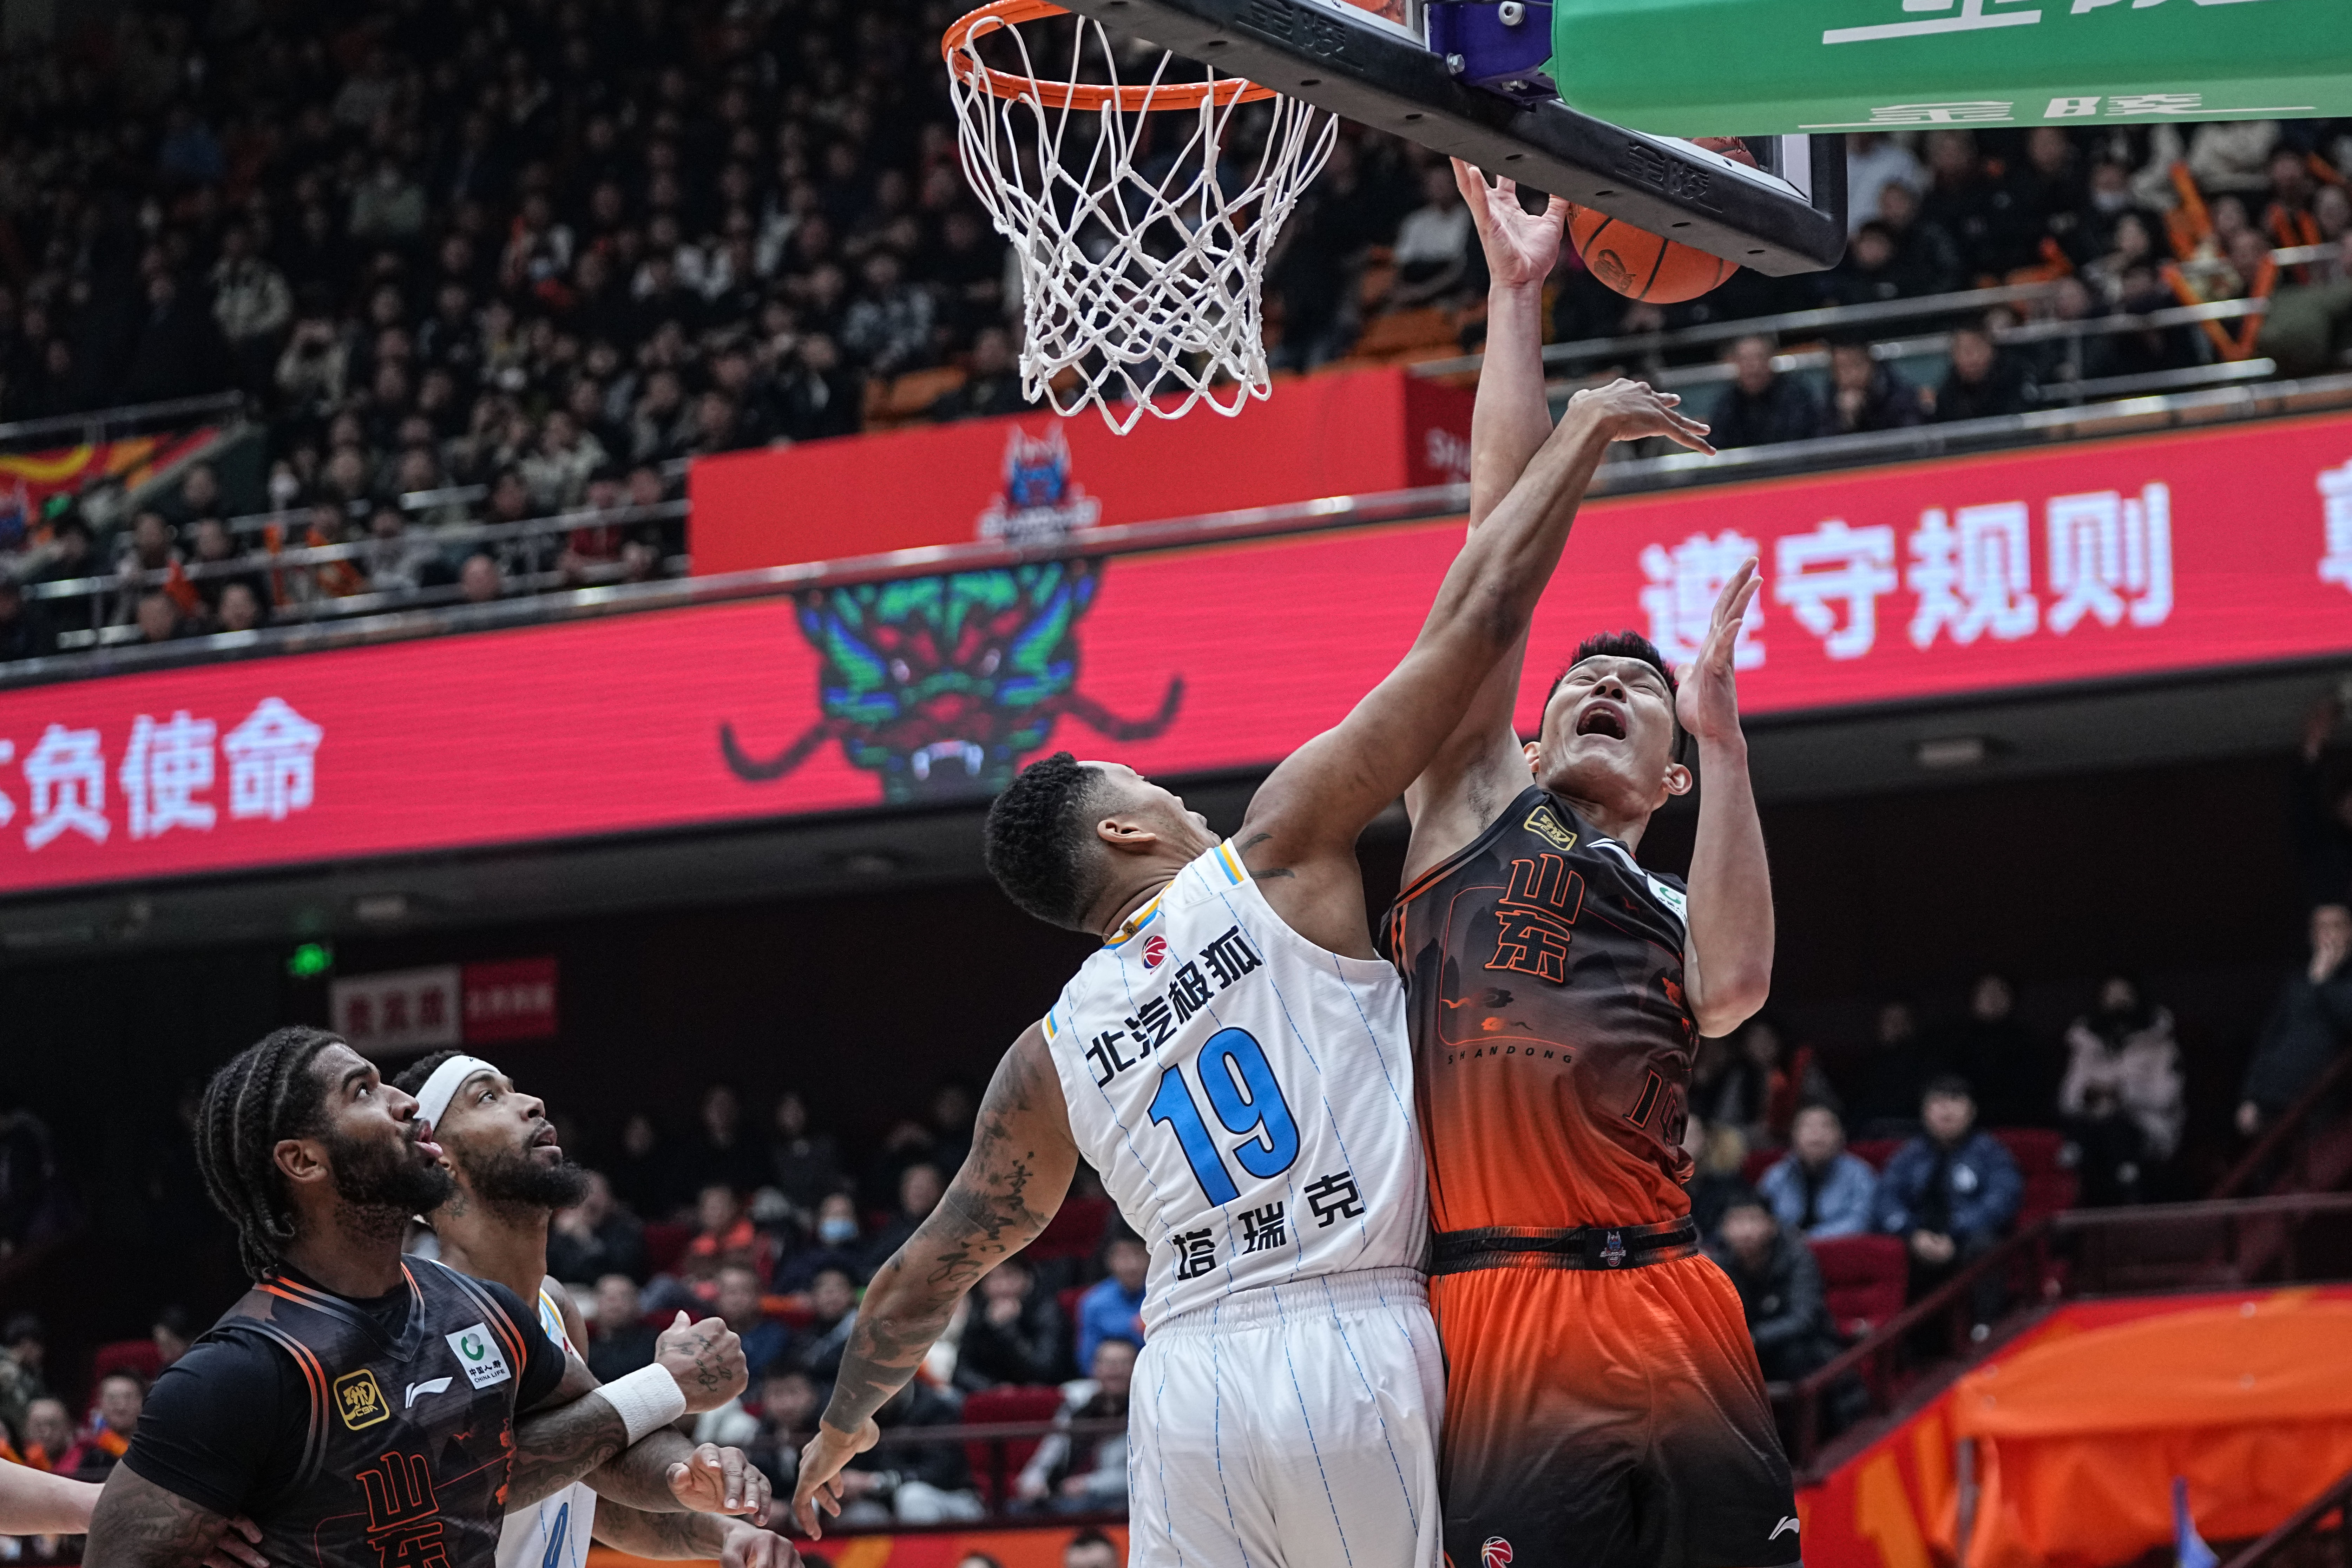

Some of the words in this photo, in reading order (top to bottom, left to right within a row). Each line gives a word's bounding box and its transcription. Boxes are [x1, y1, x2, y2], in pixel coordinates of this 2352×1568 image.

[1798, 93, 2316, 129] 金陵
[1640, 481, 2173, 670] 遵守规则
[0, 697, 324, 851] 负使命
[1485, 854, 1584, 983] 山东
[1086, 925, 1262, 1088] 北汽极狐
[1448, 1046, 1571, 1064] SHANDONG
[1148, 1027, 1300, 1208] 19
[1172, 1171, 1365, 1281] 塔瑞克
[355, 1404, 379, 1417] CBA
[469, 1360, 501, 1377] 中国人寿
[475, 1375, 490, 1383] CHINA
[491, 1369, 505, 1377] LIFE
